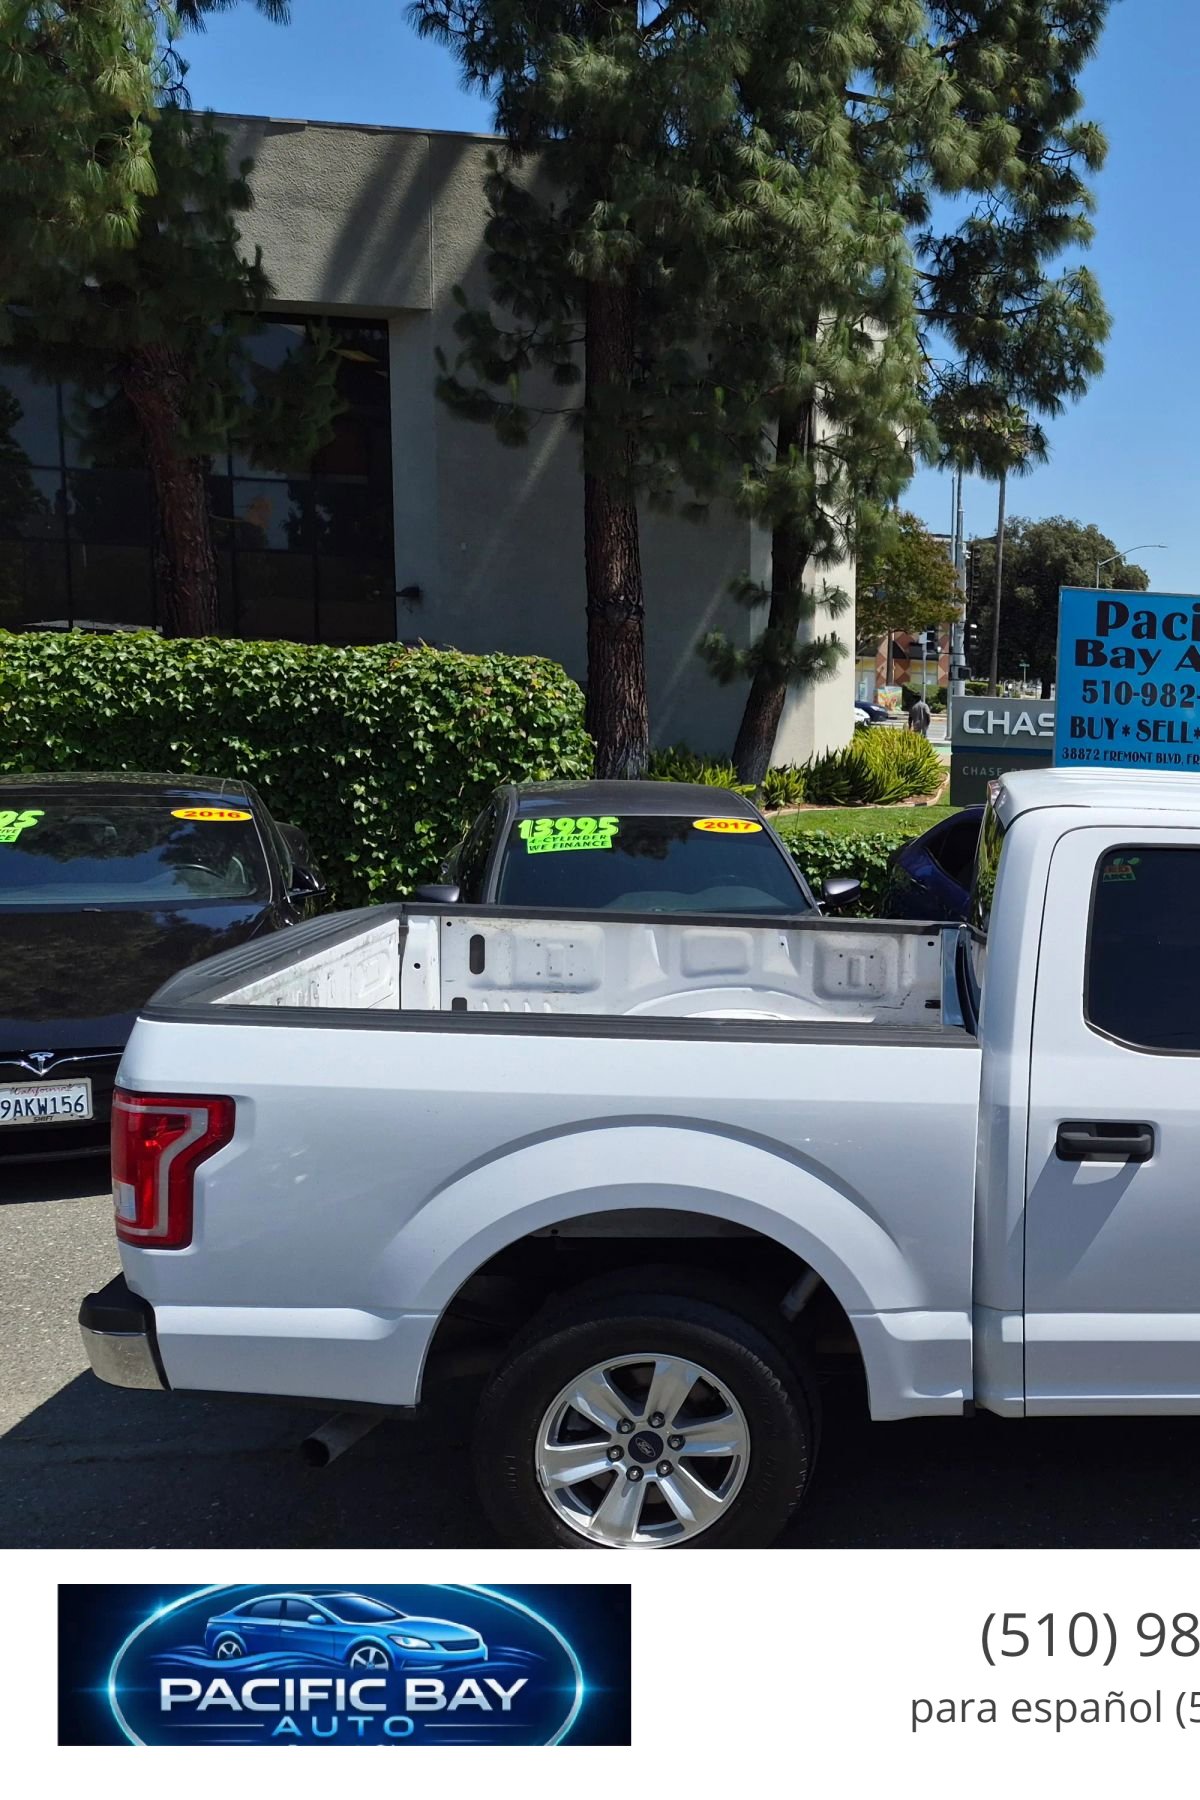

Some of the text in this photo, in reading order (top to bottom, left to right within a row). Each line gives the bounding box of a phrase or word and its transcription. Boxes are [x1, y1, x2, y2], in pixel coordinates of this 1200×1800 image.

[1075, 639, 1161, 675] Bay
[963, 710, 1055, 736] CHAS
[1070, 716, 1119, 740] BUY
[1136, 719, 1193, 743] SELL
[1062, 747, 1100, 761] 38872
[1103, 750, 1152, 764] FREMONT
[1156, 752, 1184, 766] BLVD,
[184, 810, 241, 818] 2016
[703, 821, 753, 830] 2017
[518, 816, 620, 839] 13995
[552, 841, 608, 850] FINANCE
[1, 1095, 84, 1119] 9AKW156
